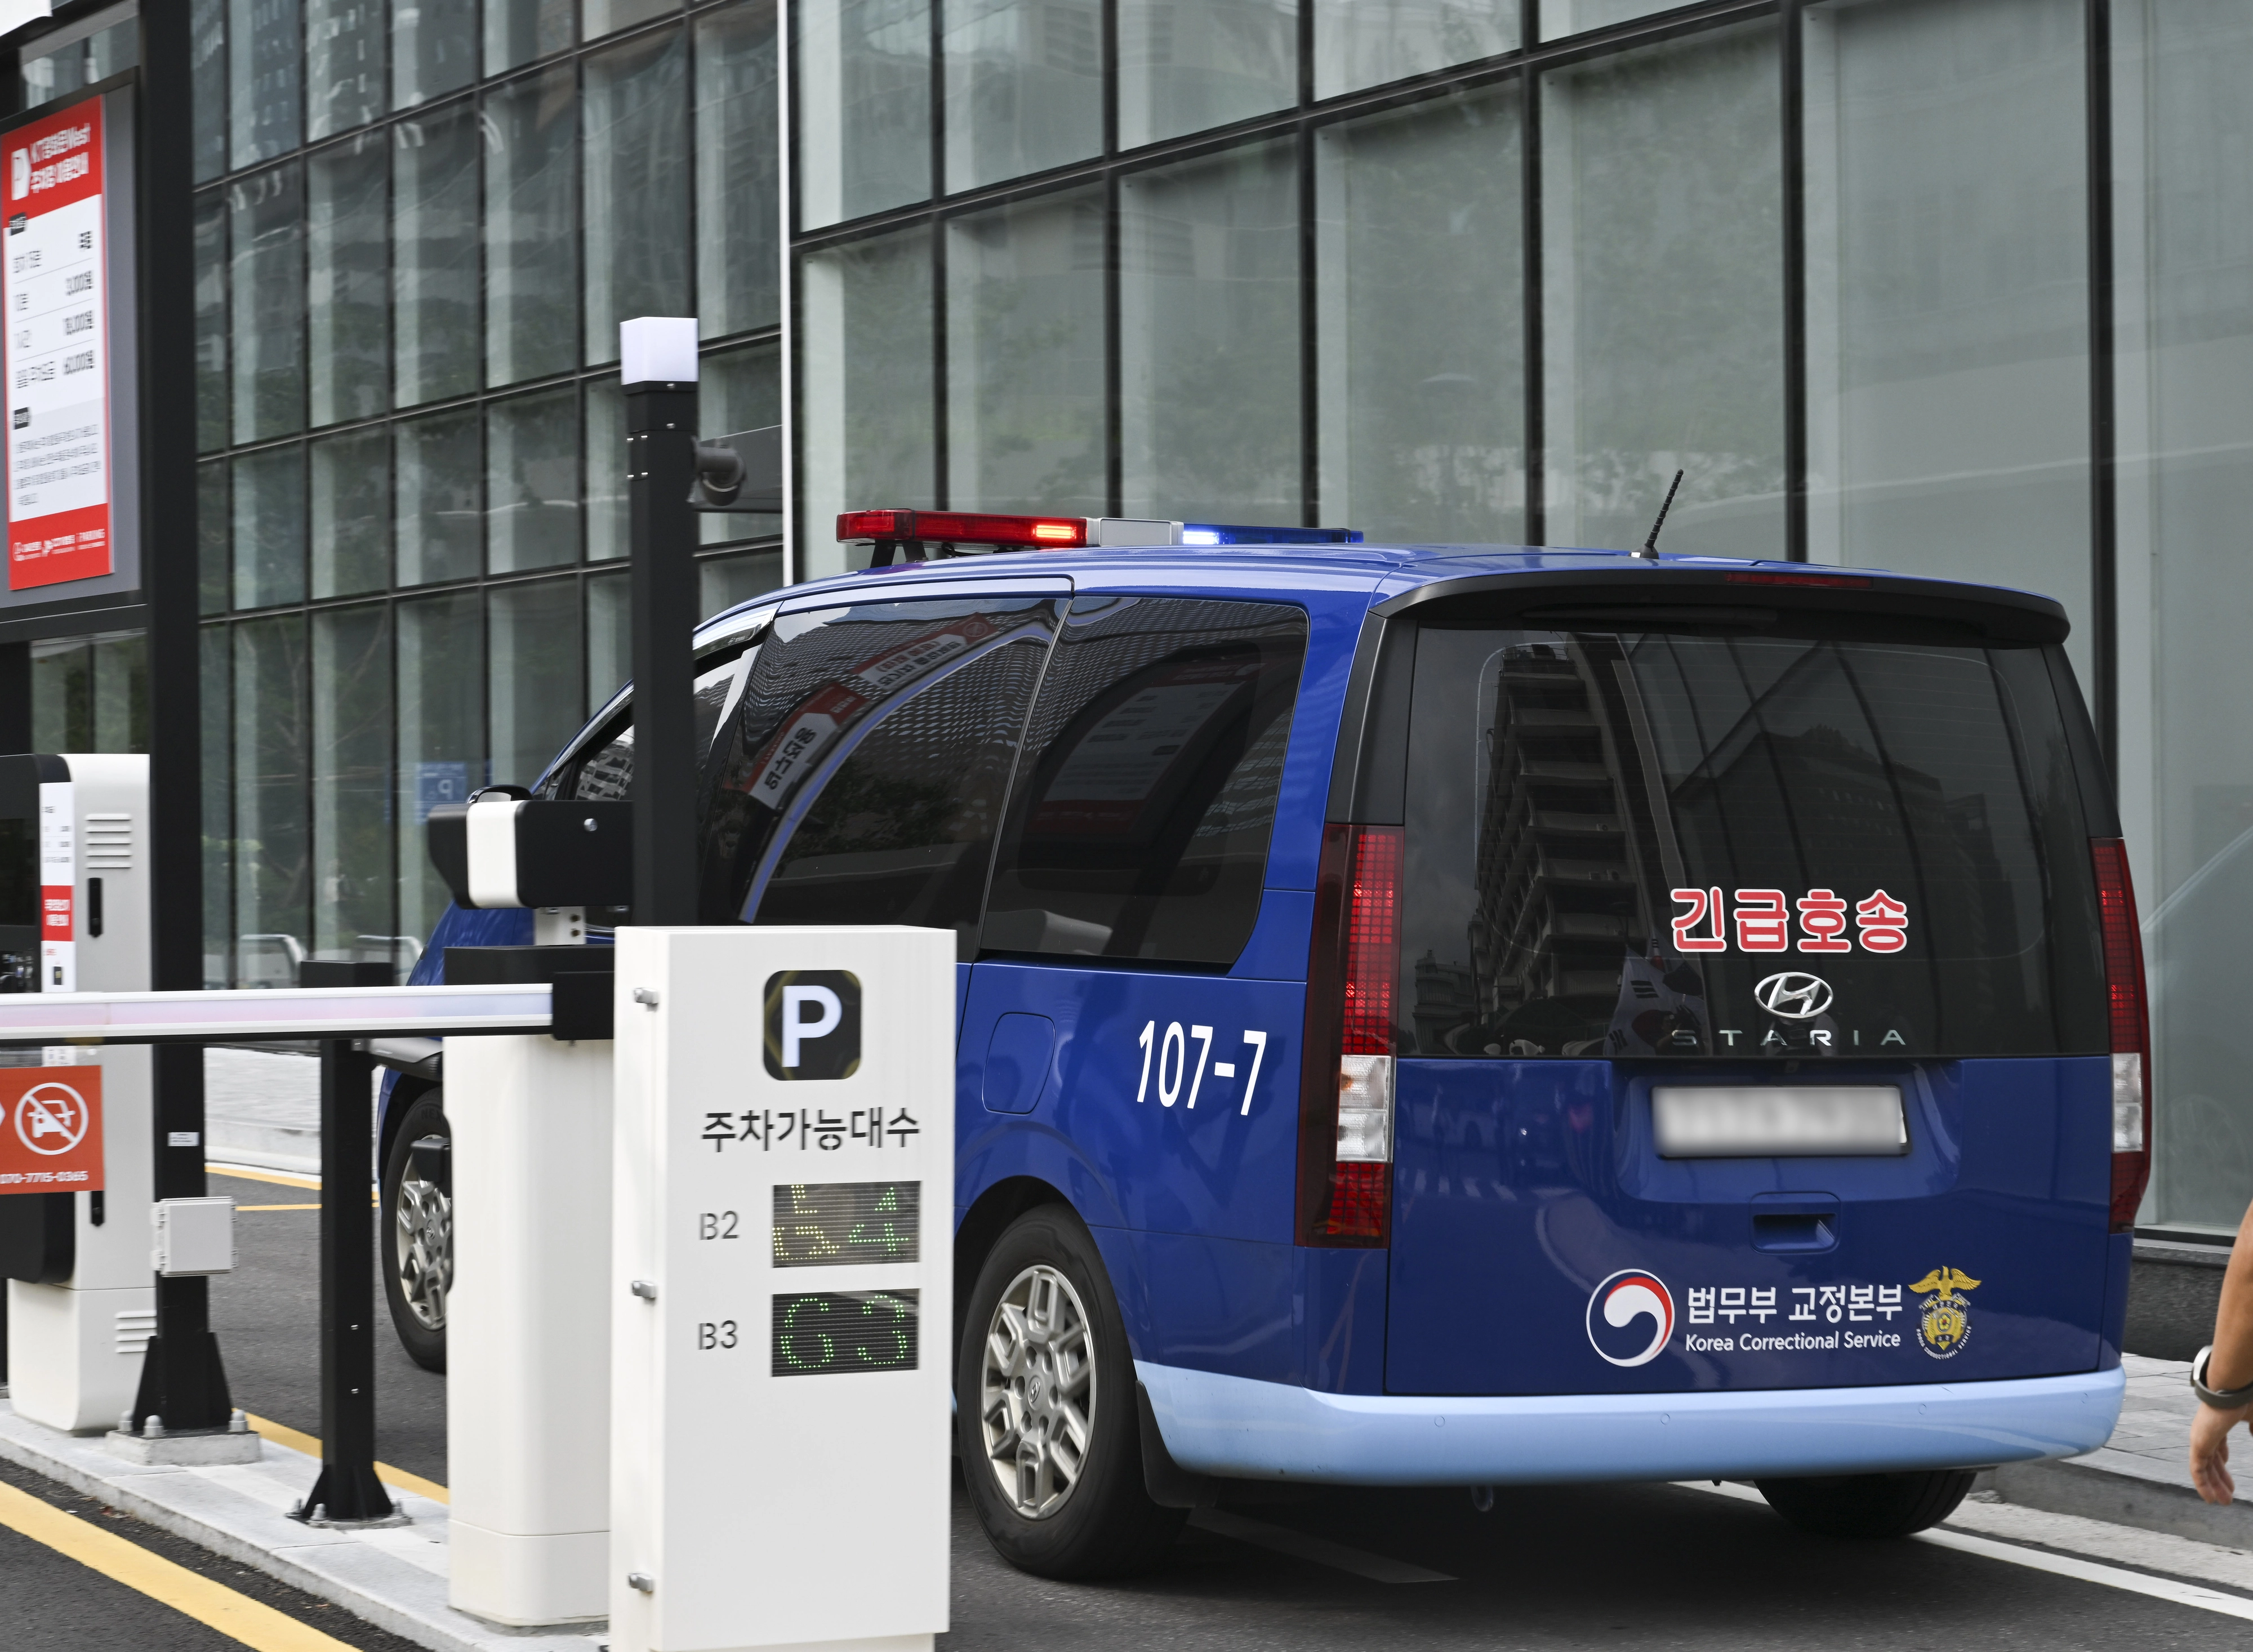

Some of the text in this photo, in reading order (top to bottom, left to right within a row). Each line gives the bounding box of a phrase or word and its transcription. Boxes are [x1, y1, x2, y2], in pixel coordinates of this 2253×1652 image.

[1671, 886, 1909, 954] 긴급호송
[782, 985, 843, 1067] P
[1672, 1029, 1907, 1047] STARIA
[1137, 1020, 1267, 1116] 107-7
[701, 1107, 921, 1153] 주차가능대수
[698, 1210, 740, 1240] B2
[1687, 1284, 1903, 1324] 법무부 교정본부
[698, 1320, 739, 1350] B3
[1685, 1330, 1901, 1351] Korea Correctional Service
